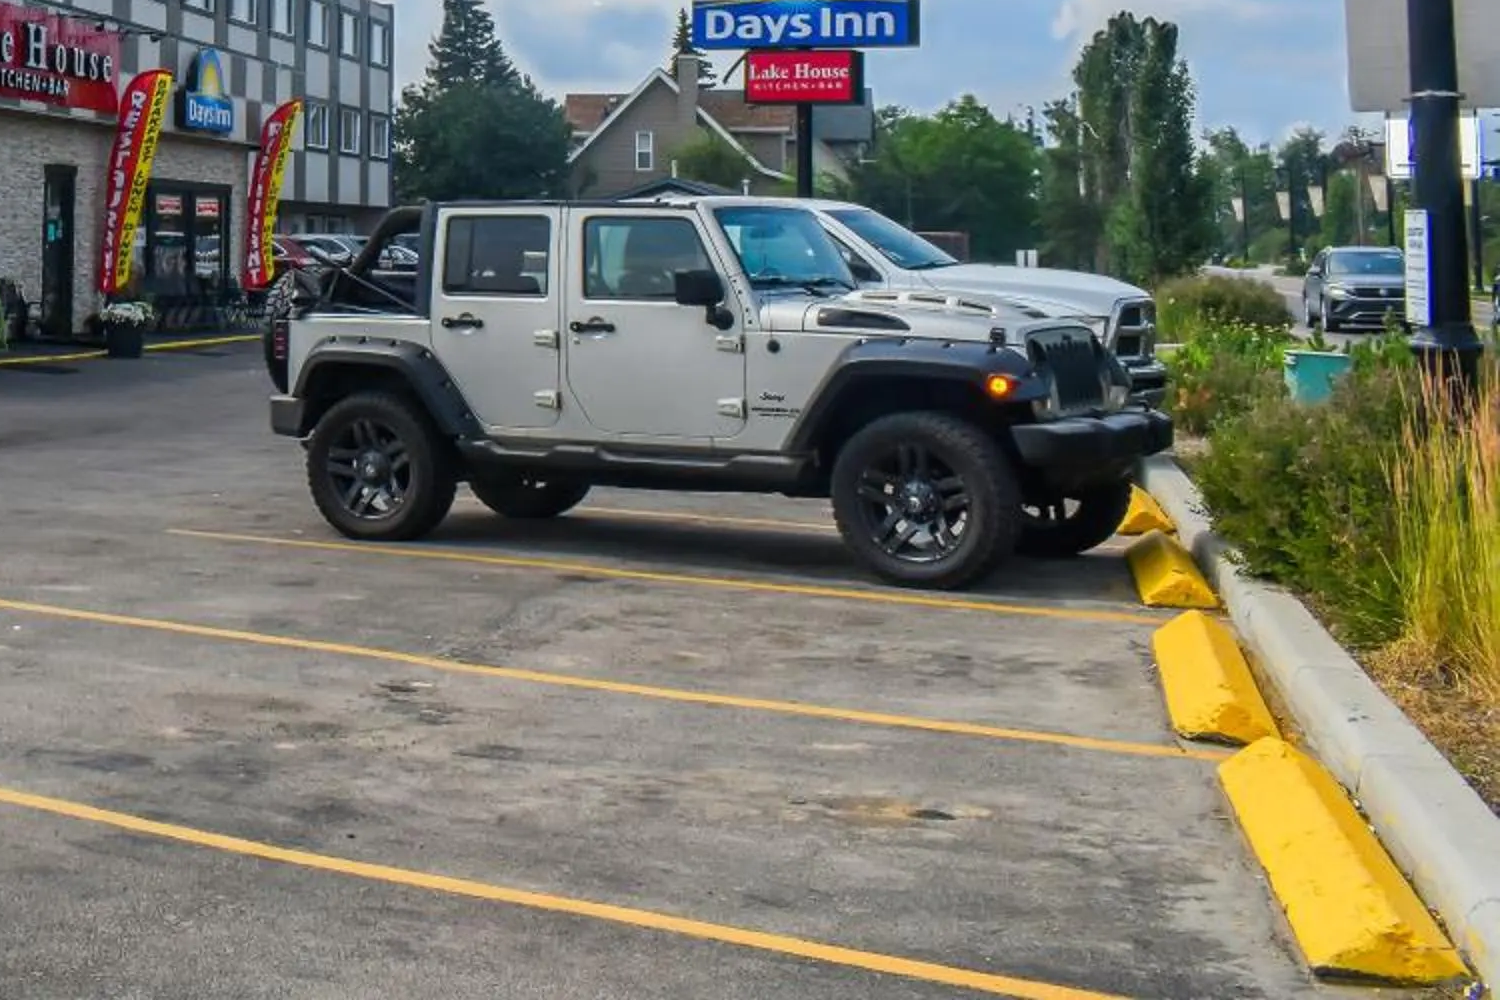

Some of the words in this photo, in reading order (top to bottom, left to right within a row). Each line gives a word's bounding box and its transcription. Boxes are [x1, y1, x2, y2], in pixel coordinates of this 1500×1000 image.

[705, 10, 811, 43] Days
[820, 7, 896, 38] Inn
[25, 21, 113, 83] House
[749, 63, 789, 80] Lake
[794, 62, 850, 79] House
